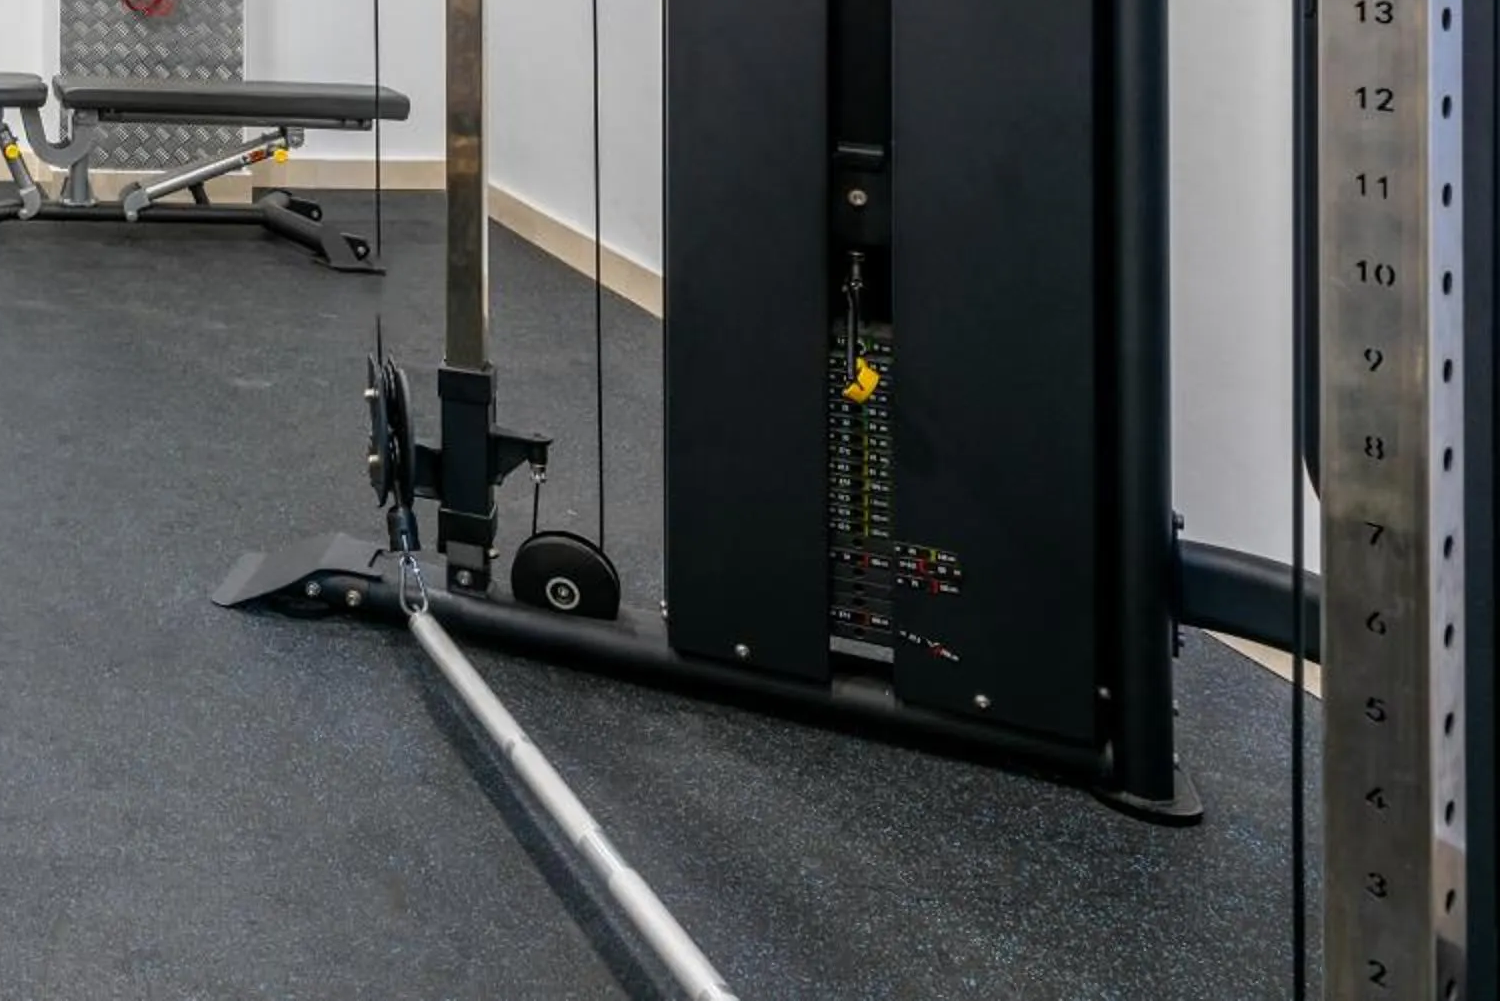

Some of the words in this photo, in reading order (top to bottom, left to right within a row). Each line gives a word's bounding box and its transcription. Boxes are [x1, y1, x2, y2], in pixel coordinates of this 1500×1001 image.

[1355, 0, 1394, 25] 13
[1355, 87, 1395, 113] 12
[1355, 173, 1389, 200] 11
[1356, 260, 1396, 288] 10
[1363, 348, 1384, 372] 9
[1364, 435, 1385, 461] 8
[1365, 522, 1385, 546] 7
[1366, 611, 1387, 636] 6
[1366, 697, 1388, 723] 5
[1365, 786, 1388, 810] 4
[1366, 872, 1388, 899] 3
[1367, 960, 1388, 987] 2
